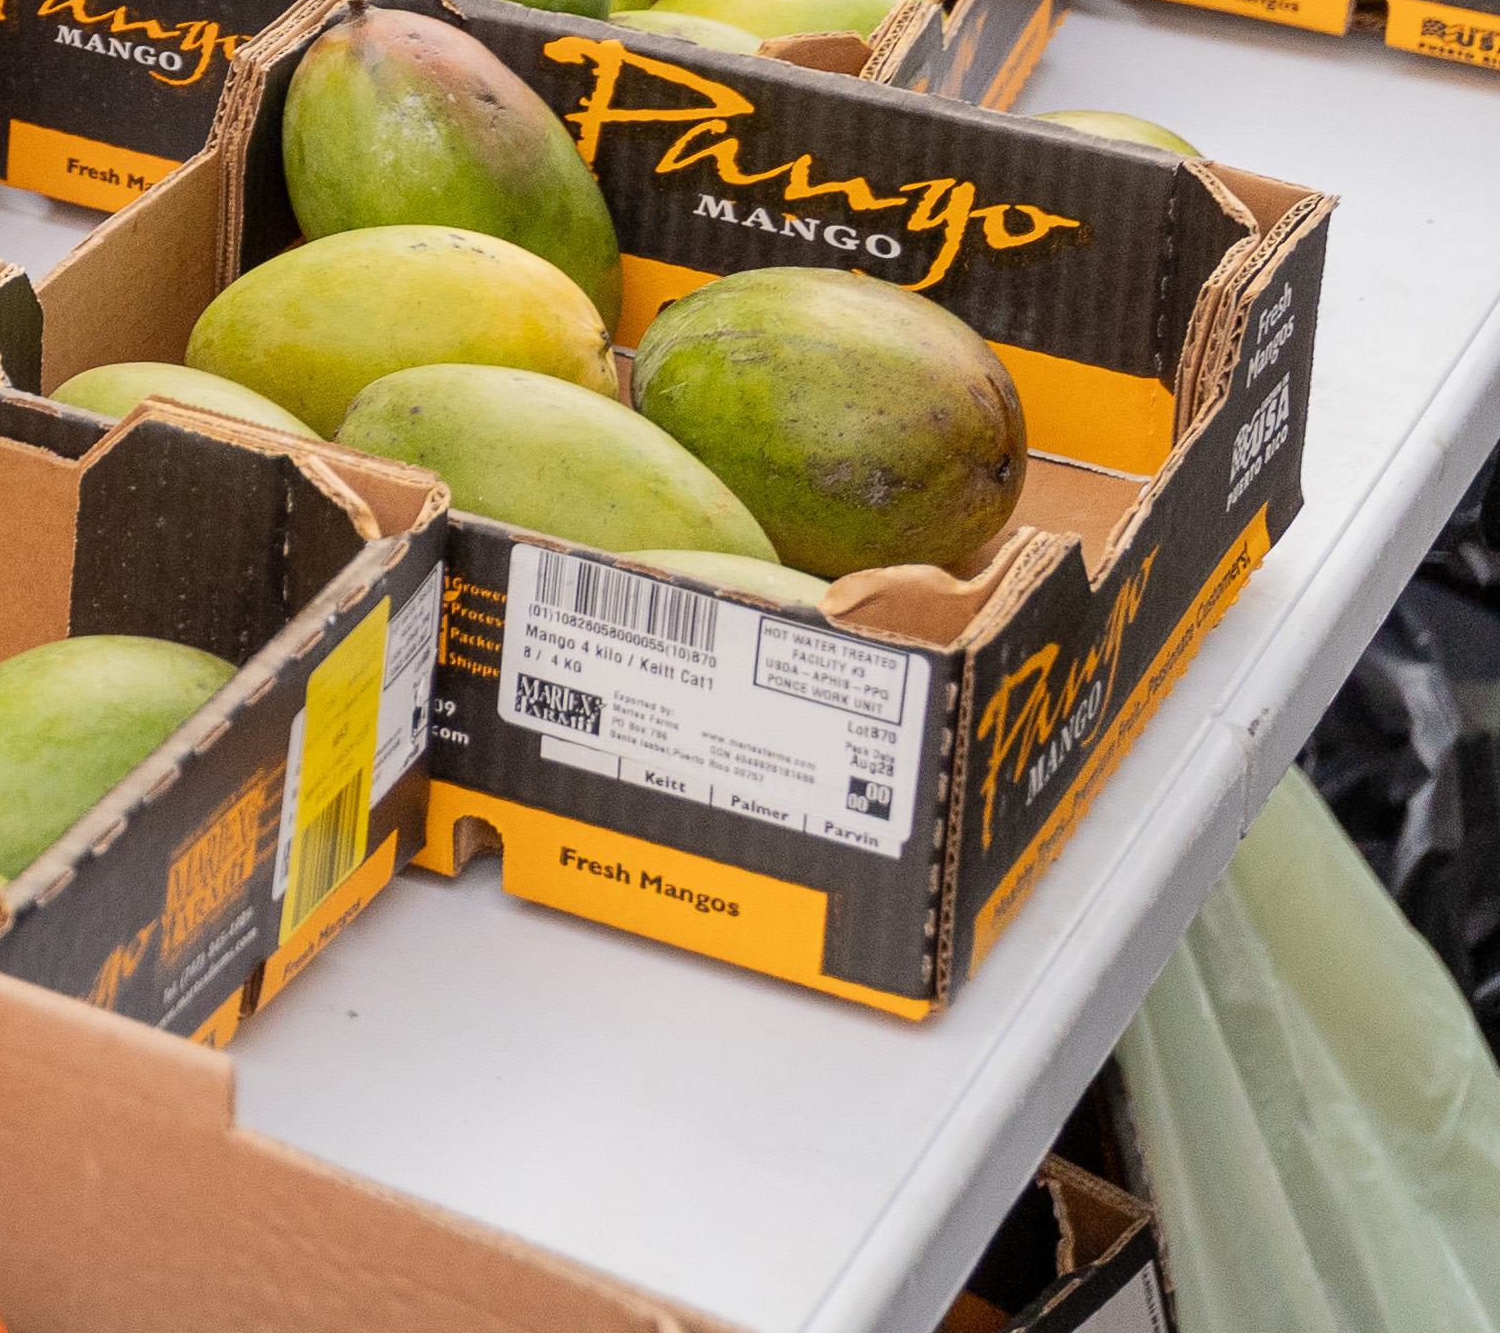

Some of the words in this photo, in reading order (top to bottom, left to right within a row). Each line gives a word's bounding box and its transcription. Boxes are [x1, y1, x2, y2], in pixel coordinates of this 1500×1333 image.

[54, 24, 184, 72] MANGO
[65, 156, 121, 186] Fresh
[542, 35, 1081, 292] Pango
[692, 193, 903, 261] MANGO
[1256, 281, 1293, 345] Fresh
[1245, 314, 1296, 390] Mangos
[451, 577, 507, 604] Grower
[450, 626, 502, 652] Packer
[525, 622, 576, 654] Mango
[580, 639, 591, 655] 4
[595, 643, 624, 666] kilo
[639, 653, 676, 681] Keitt
[680, 662, 715, 691] Cat1
[549, 653, 561, 668] 4
[763, 625, 788, 642] HOT
[792, 633, 837, 655] WATER
[841, 646, 897, 671] TREATED
[791, 648, 847, 674] FACILITY
[765, 656, 799, 677] USDA
[811, 669, 851, 690] APHIS
[863, 683, 890, 701] PPQ
[766, 672, 807, 695] PONCE
[811, 685, 849, 706] WORK
[854, 697, 885, 715] UNIT
[976, 544, 1161, 856] Pango
[1025, 679, 1103, 807] MANGO
[644, 769, 687, 794] Keitt
[730, 794, 791, 822] Palmer
[824, 820, 880, 849] Parvin
[558, 844, 632, 886] Fresh
[639, 870, 741, 919] Mangos
